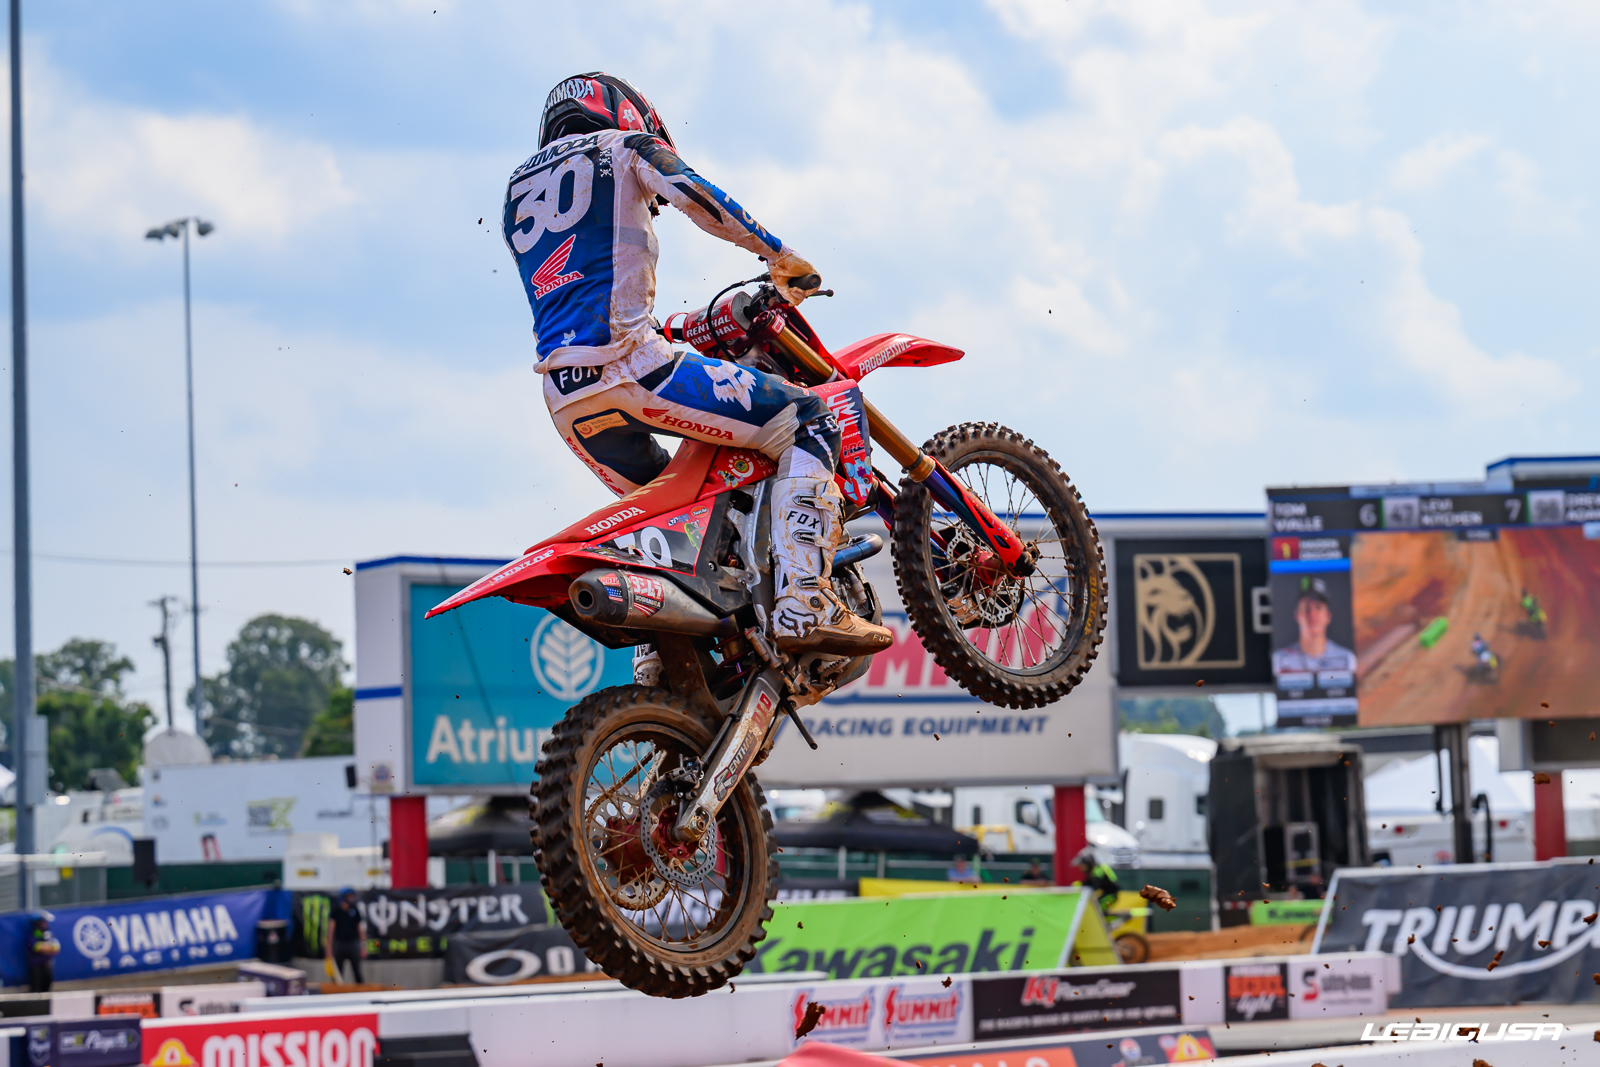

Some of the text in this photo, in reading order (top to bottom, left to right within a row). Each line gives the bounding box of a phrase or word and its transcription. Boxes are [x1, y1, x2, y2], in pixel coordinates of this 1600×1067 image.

[510, 134, 598, 178] SHIMODA
[511, 153, 595, 254] 30
[534, 270, 584, 300] HONDA
[858, 340, 911, 377] PROGRESSIVE
[660, 414, 734, 441] HONDA
[843, 440, 865, 457] HRC
[584, 506, 646, 536] HONDA
[786, 510, 820, 529] FOX
[1359, 504, 1377, 527] 6
[1420, 511, 1483, 526] KITCHEN
[1504, 499, 1522, 522] 7
[492, 548, 555, 582] DUNLOP
[803, 715, 1049, 737] RACING EQUIPMENT
[107, 904, 239, 953] YAMAHA
[92, 942, 233, 971] RACING
